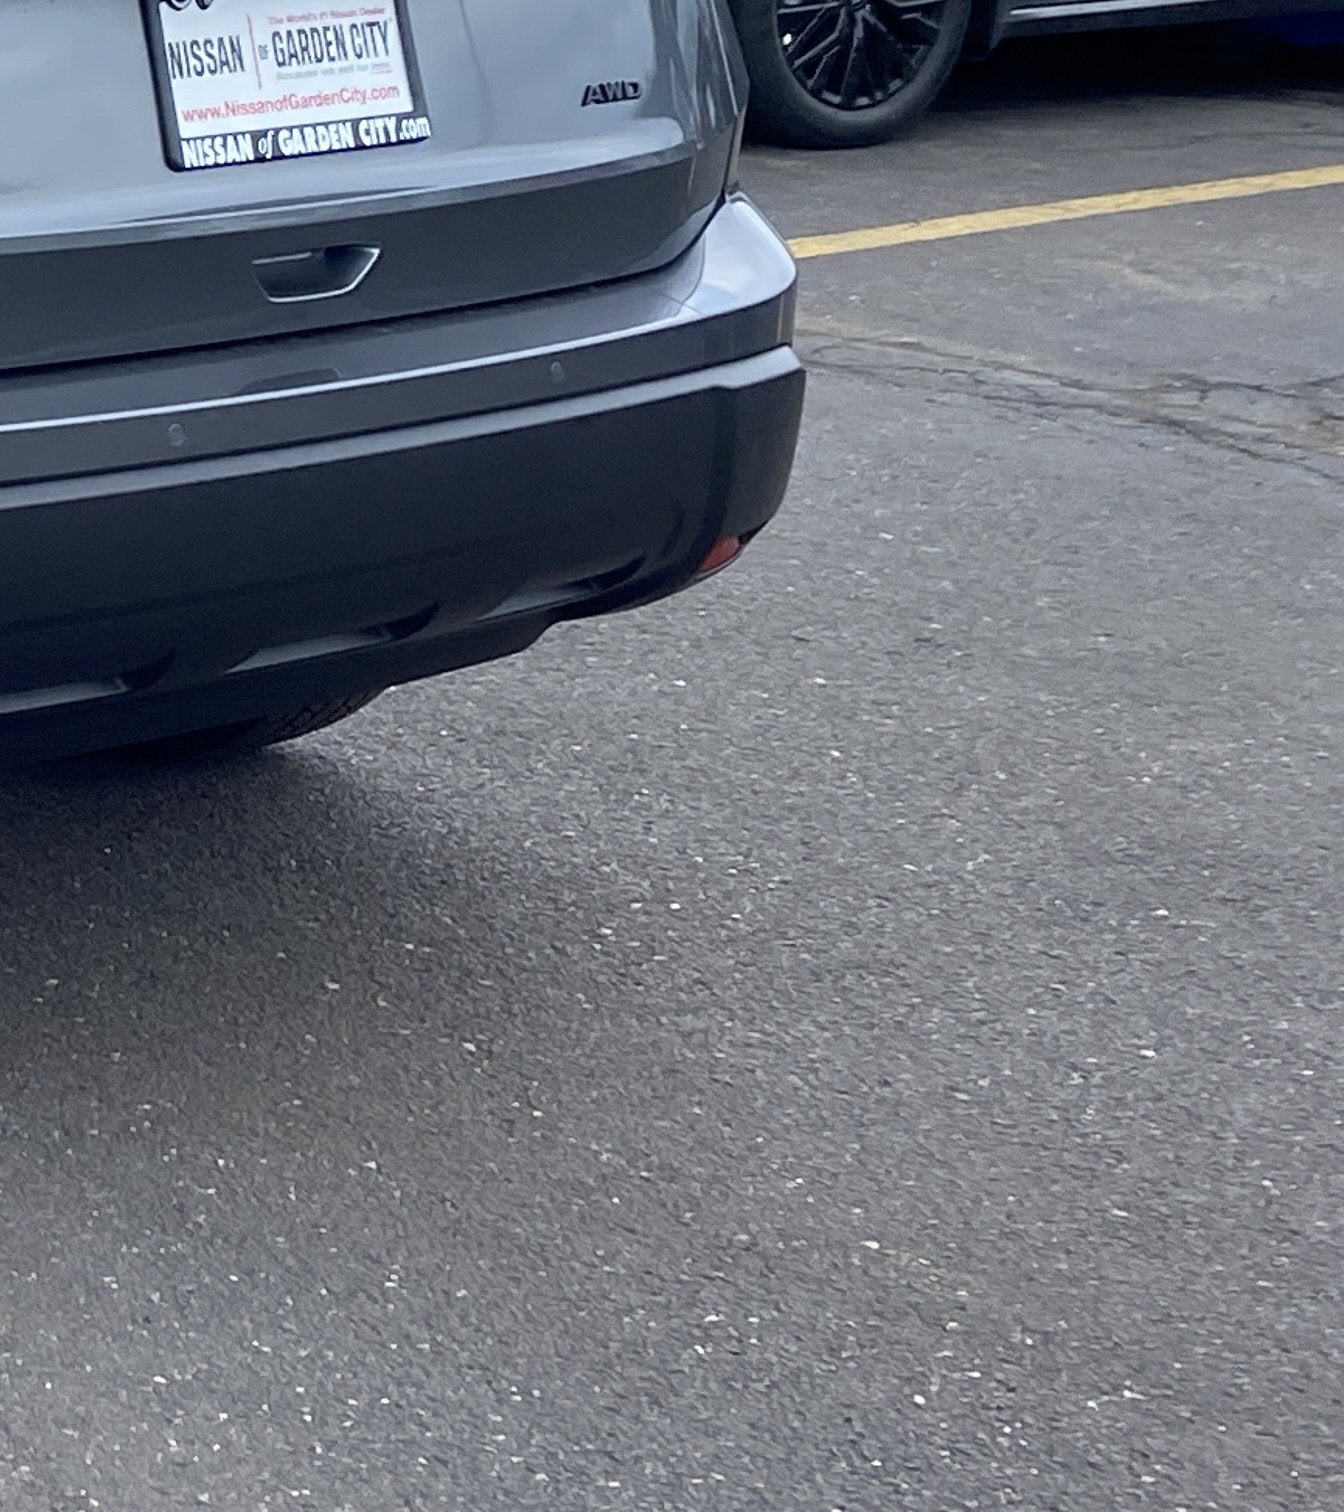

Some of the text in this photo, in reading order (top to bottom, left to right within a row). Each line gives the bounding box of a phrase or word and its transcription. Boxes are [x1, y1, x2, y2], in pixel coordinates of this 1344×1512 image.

[167, 35, 246, 80] NISSAN
[272, 23, 348, 68] GARDEN
[349, 20, 390, 60] CITY
[181, 85, 400, 123] www.NissanofGardenCity.com
[580, 80, 640, 107] AWD
[180, 133, 255, 169] NISSAN
[257, 130, 275, 160] of
[278, 122, 355, 157] GARDEN
